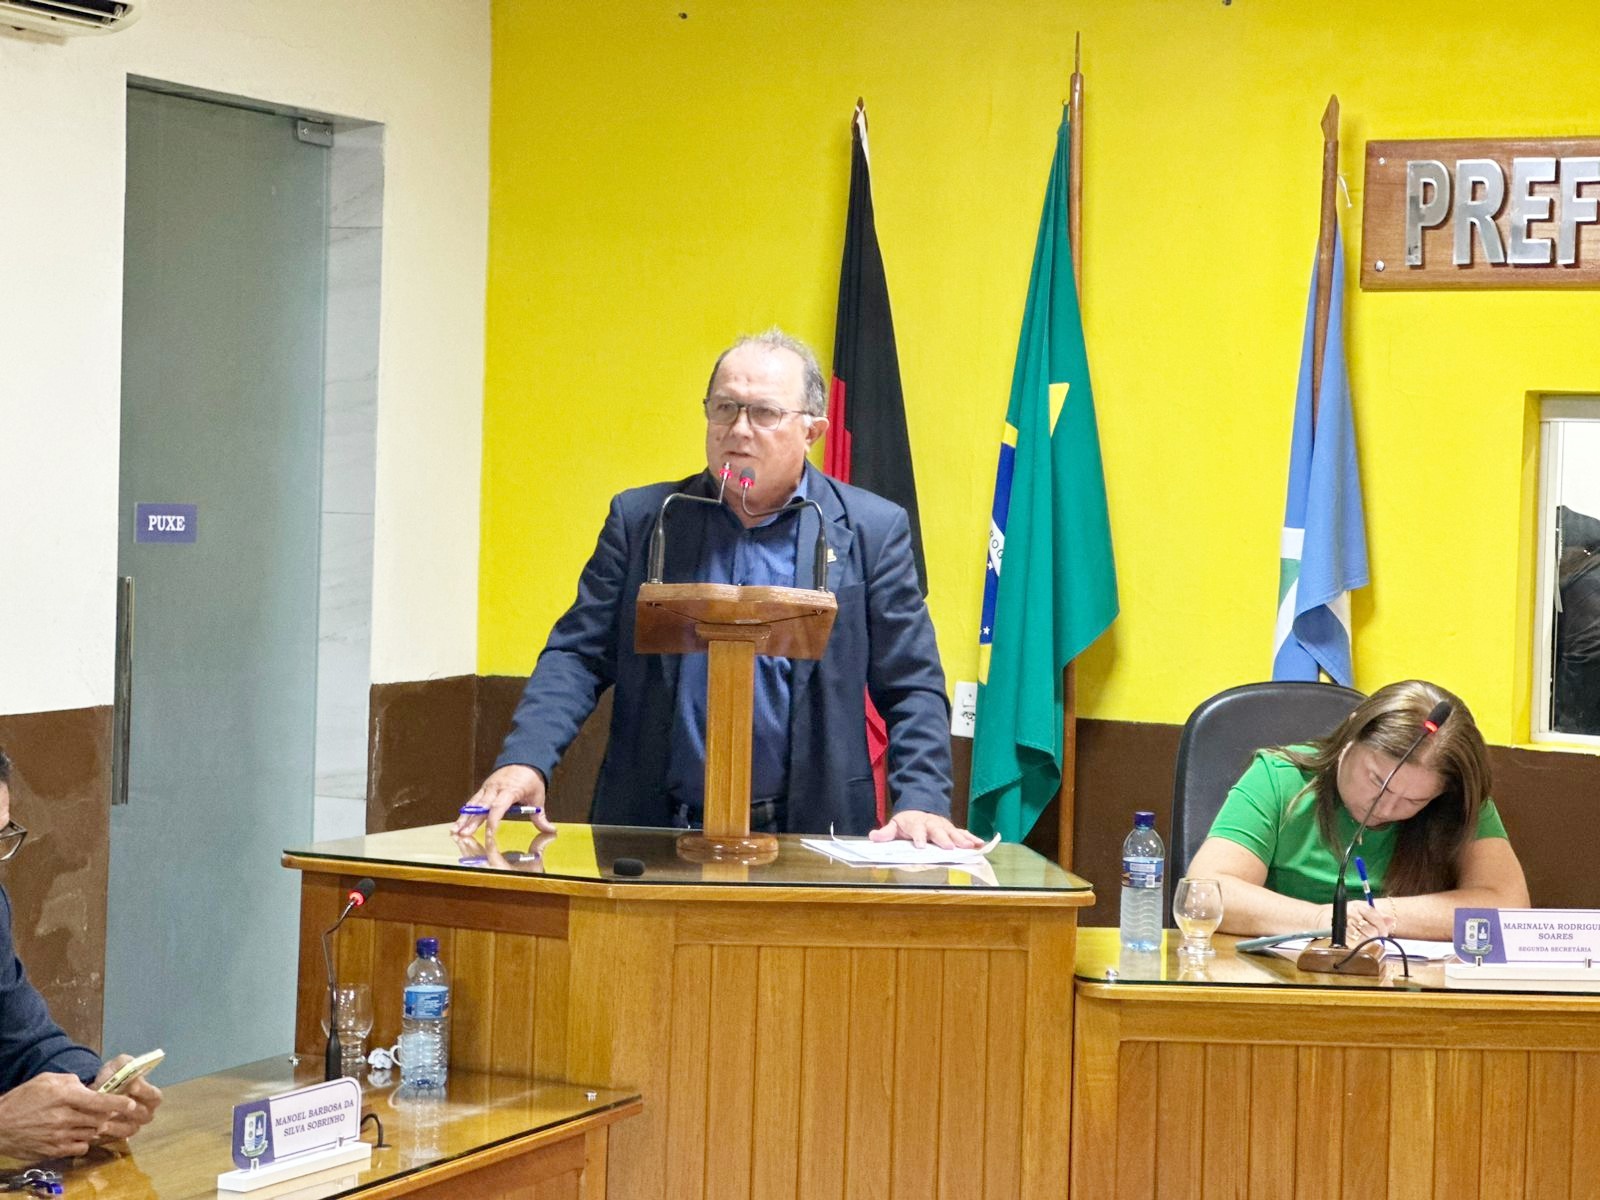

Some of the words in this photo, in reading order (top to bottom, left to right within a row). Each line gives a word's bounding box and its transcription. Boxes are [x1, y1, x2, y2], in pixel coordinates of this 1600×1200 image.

[1406, 157, 1600, 266] PREF
[148, 515, 186, 531] PUXE
[275, 1112, 306, 1127] MANOEL
[308, 1103, 342, 1118] BARBOSA
[344, 1099, 354, 1109] DA
[283, 1124, 305, 1137] SILVA
[307, 1114, 345, 1130] SOBRINHO
